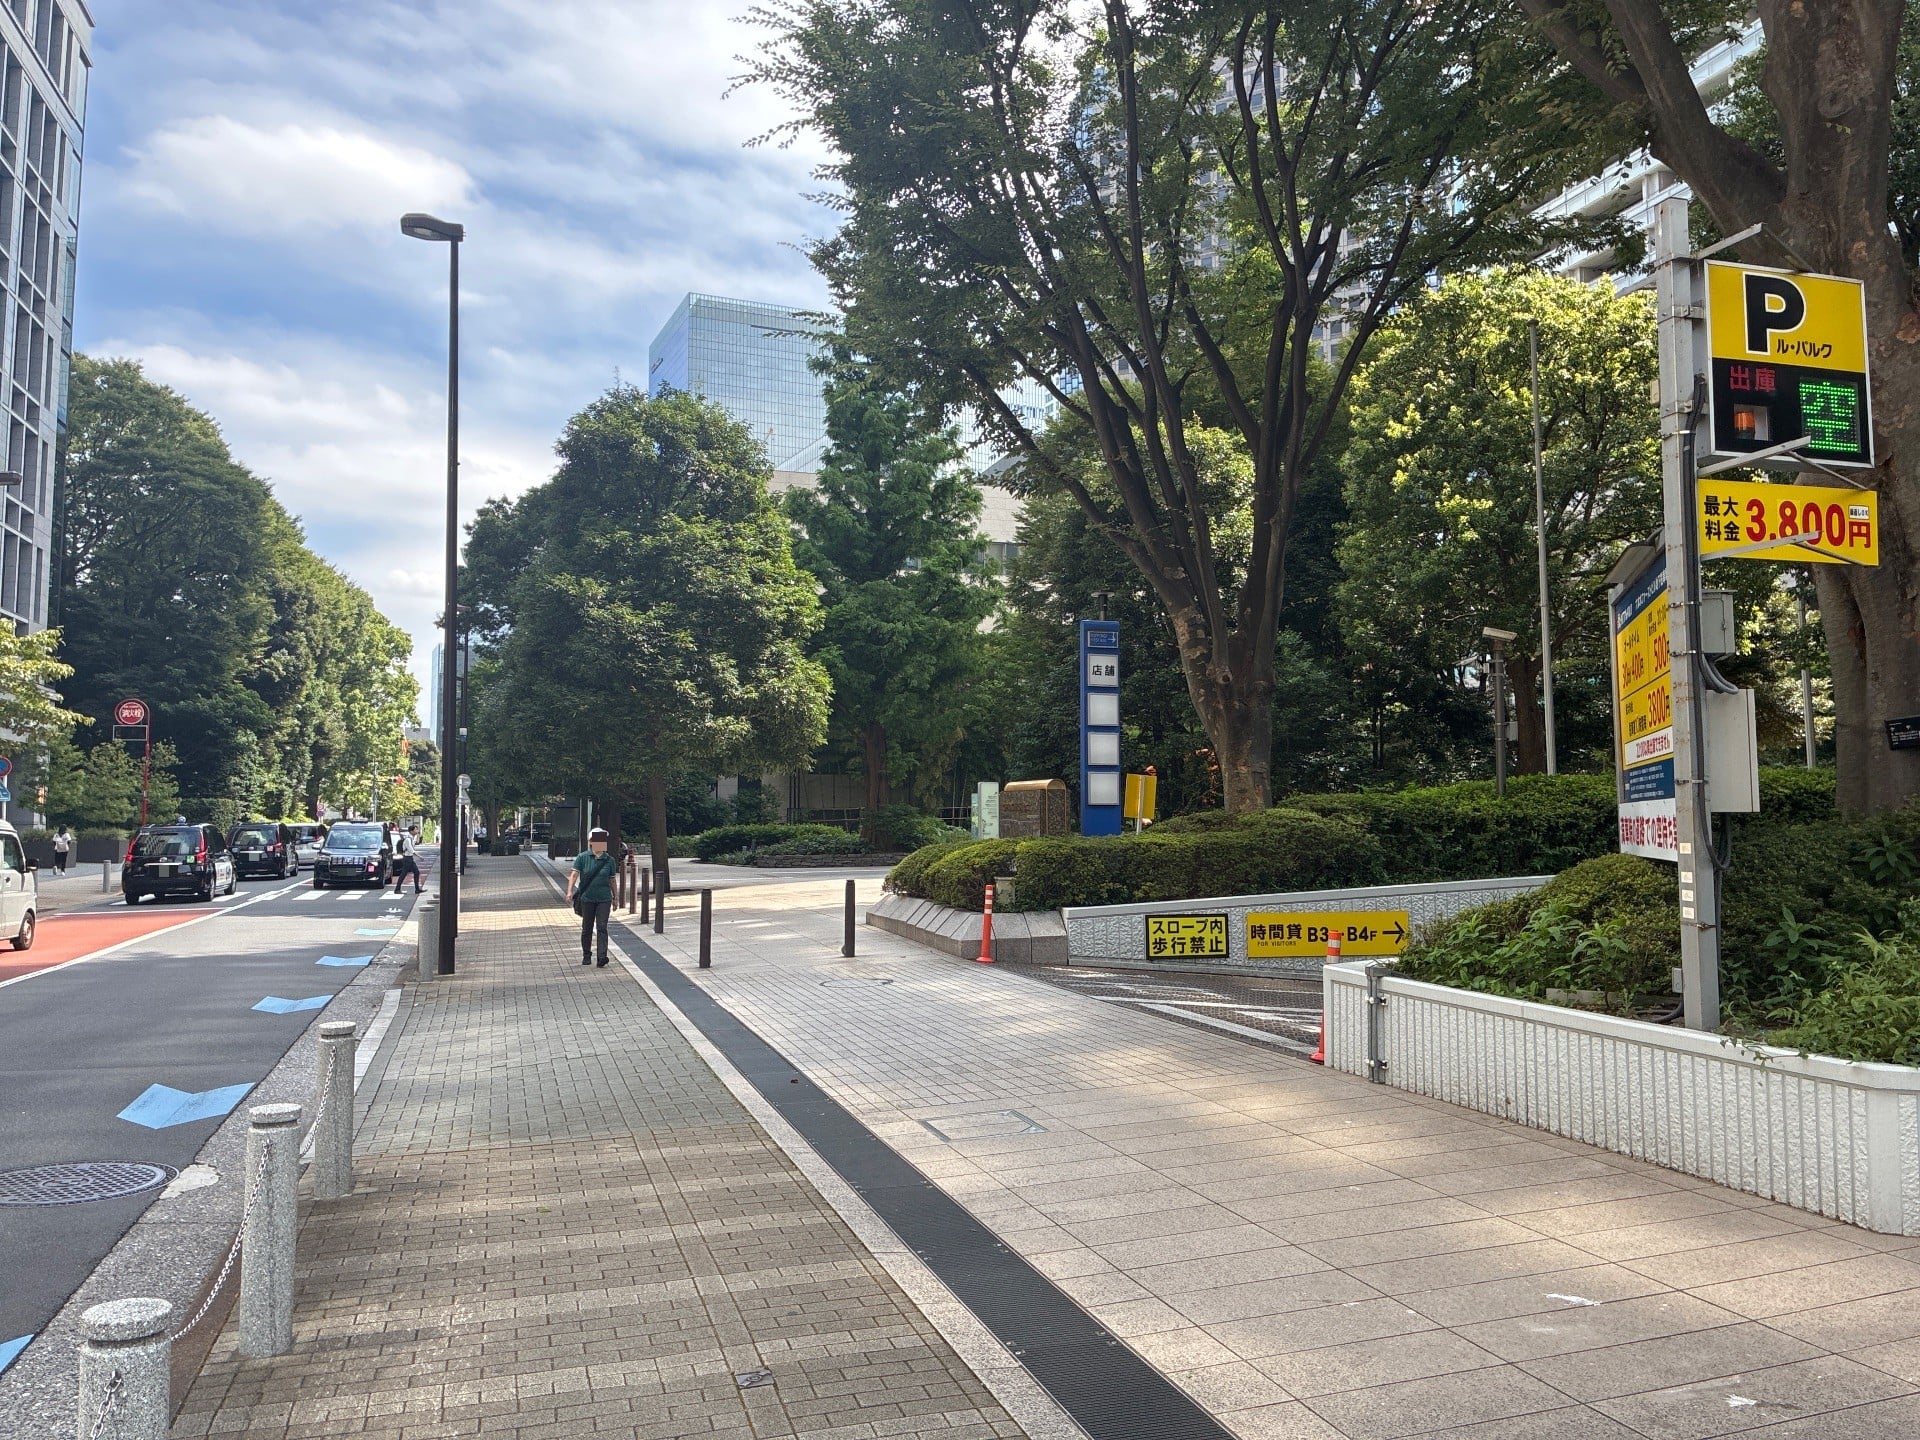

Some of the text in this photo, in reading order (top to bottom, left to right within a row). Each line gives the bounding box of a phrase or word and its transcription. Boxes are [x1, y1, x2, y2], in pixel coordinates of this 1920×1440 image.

[1743, 272, 1806, 354] P
[1730, 365, 1776, 392] 出庫
[1800, 382, 1858, 451] 空
[1704, 495, 1739, 517] 最大
[1705, 519, 1740, 541] 料金
[1092, 664, 1115, 677] 店舗
[121, 708, 141, 717] 消火栓
[1153, 918, 1222, 935] スロープ内
[1251, 923, 1302, 940] 時間貸
[1152, 936, 1223, 954] 歩行禁止
